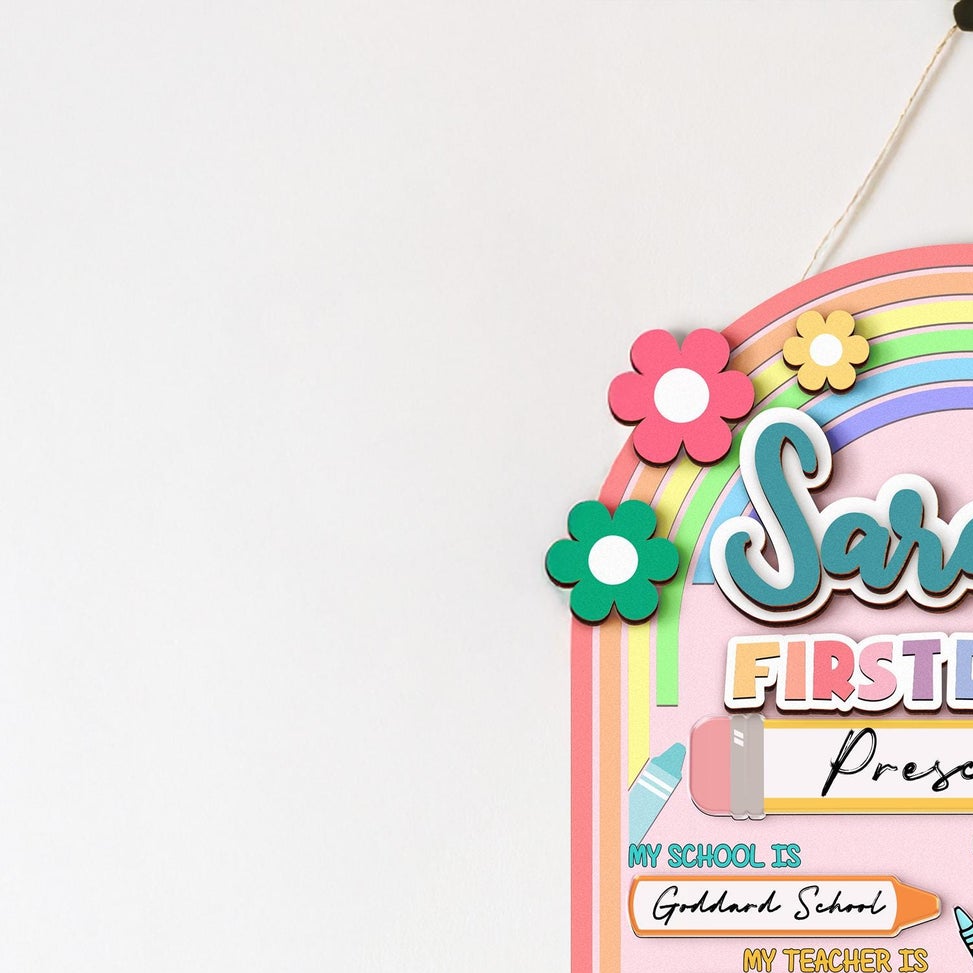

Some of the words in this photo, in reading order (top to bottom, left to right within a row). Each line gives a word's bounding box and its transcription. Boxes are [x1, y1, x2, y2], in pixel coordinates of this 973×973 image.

[730, 637, 943, 702] FIRST
[628, 844, 662, 868] MY
[667, 844, 765, 868] SCHOOL
[771, 844, 801, 868] IS
[652, 885, 781, 926] Goddard
[794, 885, 887, 921] School
[743, 948, 777, 973] MY
[782, 948, 892, 973] TEACHER
[898, 948, 929, 973] IS
